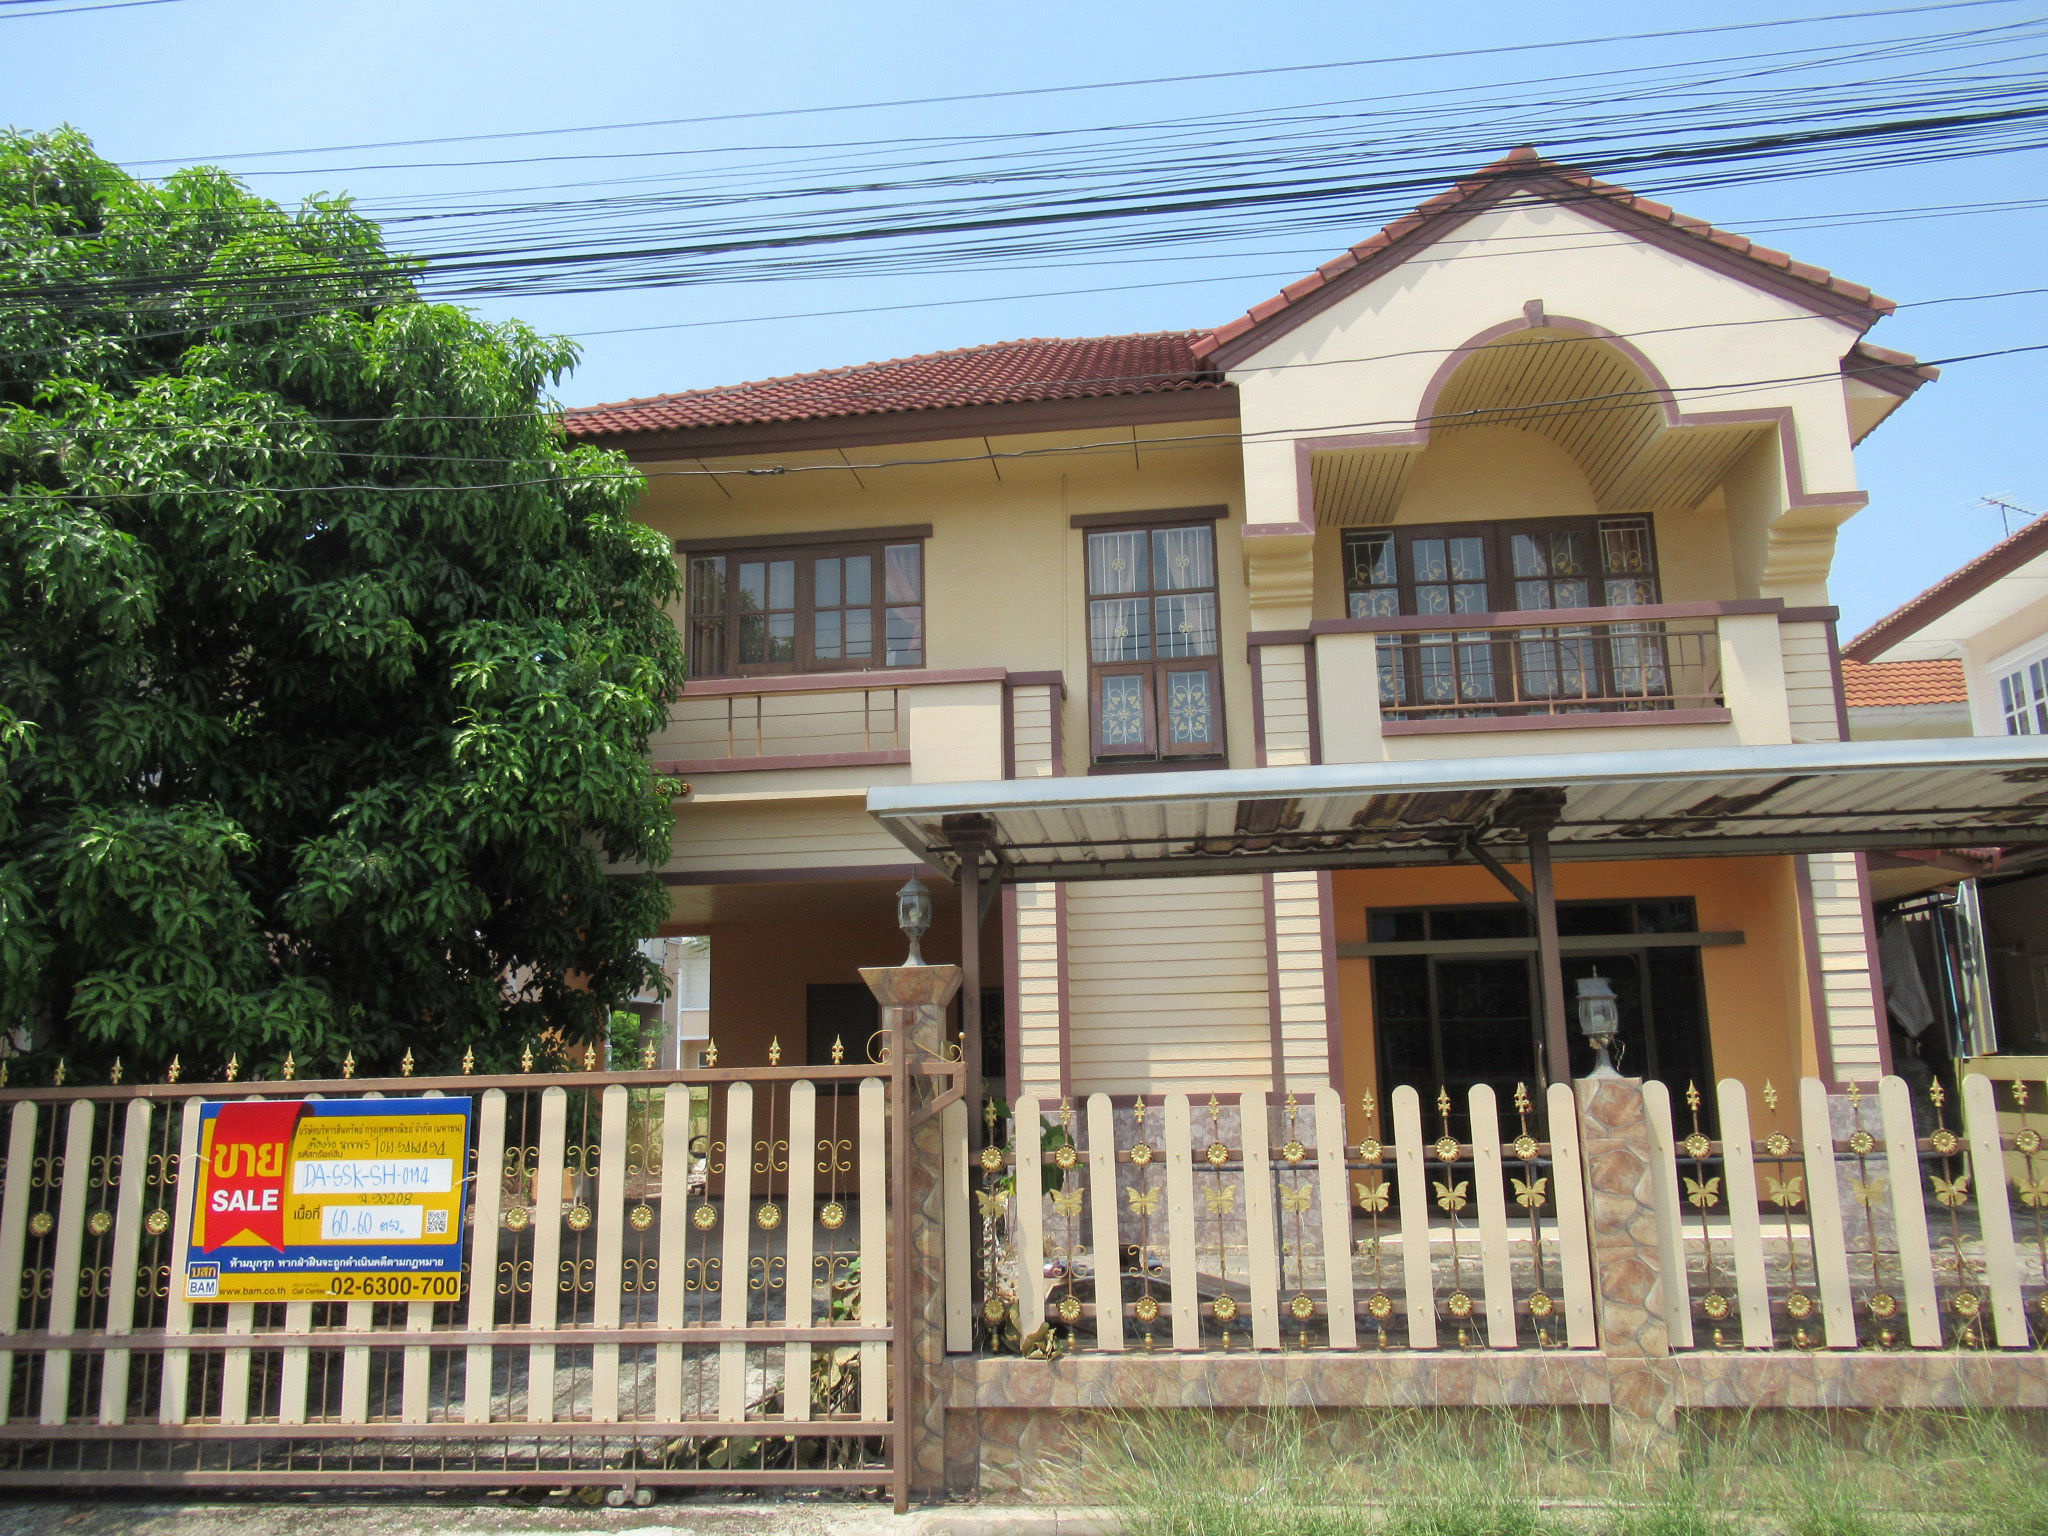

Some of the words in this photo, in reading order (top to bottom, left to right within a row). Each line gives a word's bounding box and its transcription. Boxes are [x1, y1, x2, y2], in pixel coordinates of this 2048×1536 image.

[415, 1122, 432, 1134] จำกัด
[434, 1124, 463, 1135] (มหาชน)
[213, 1143, 284, 1178] ขาย
[211, 1188, 279, 1212] SALE
[293, 1203, 320, 1220] เนื้อที่
[331, 1207, 373, 1237] 60.60
[191, 1265, 216, 1278] บสก
[230, 1257, 275, 1271] ห้ามบุกรุก
[190, 1281, 215, 1293] BAM
[219, 1286, 286, 1295] www.bam.co.th
[331, 1276, 458, 1296] 02-6300-700
